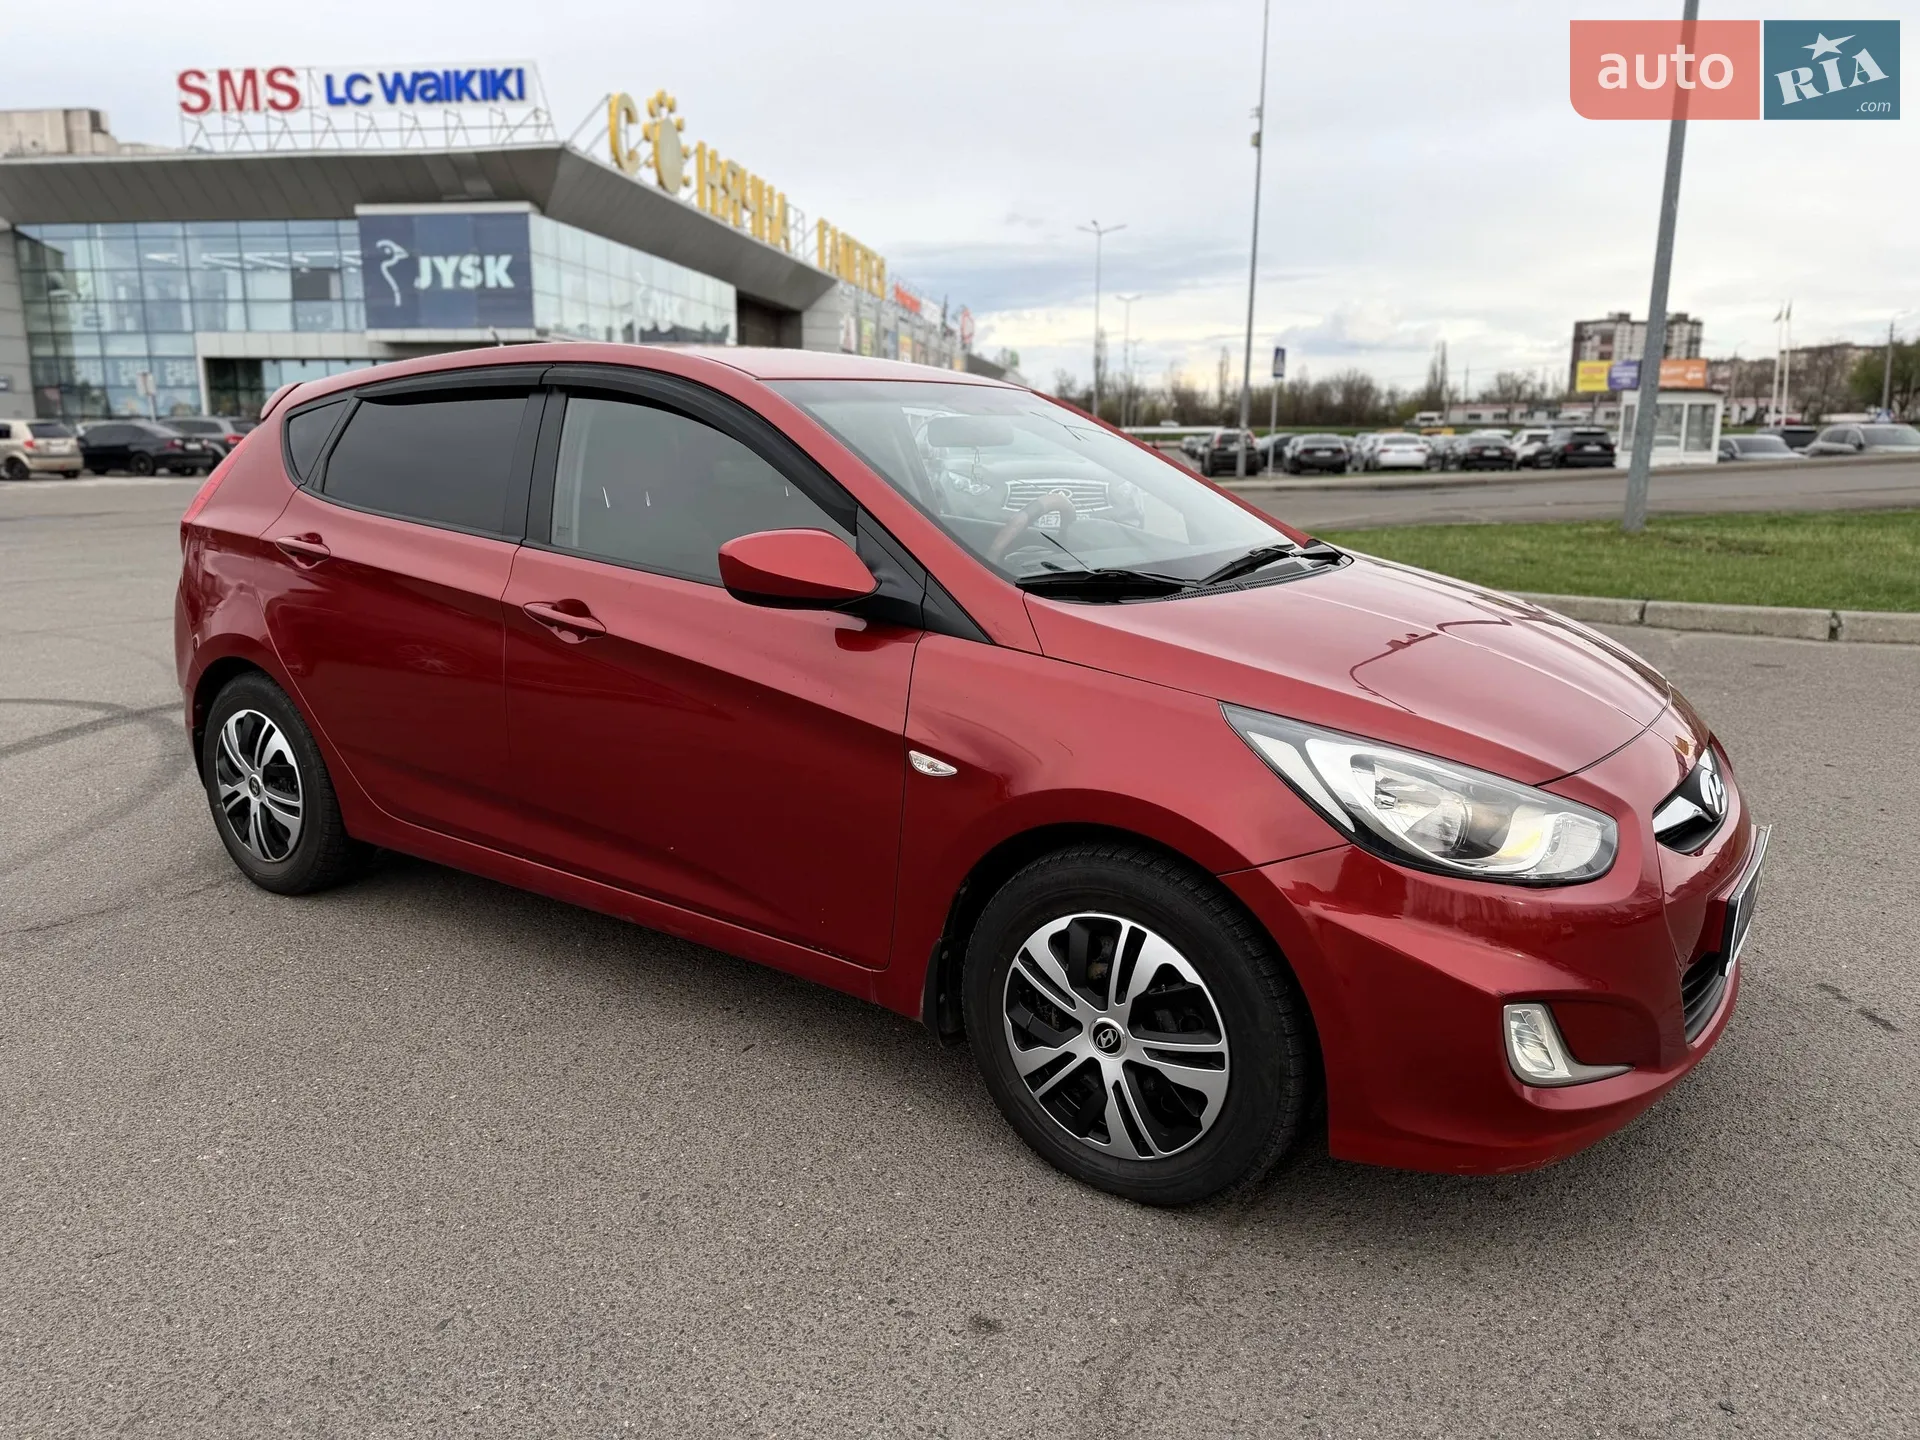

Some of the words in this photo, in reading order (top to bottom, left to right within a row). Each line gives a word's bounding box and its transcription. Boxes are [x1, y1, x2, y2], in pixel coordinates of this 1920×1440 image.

[177, 65, 302, 115] SMS
[325, 73, 373, 107] LC
[413, 253, 516, 290] JYSK
